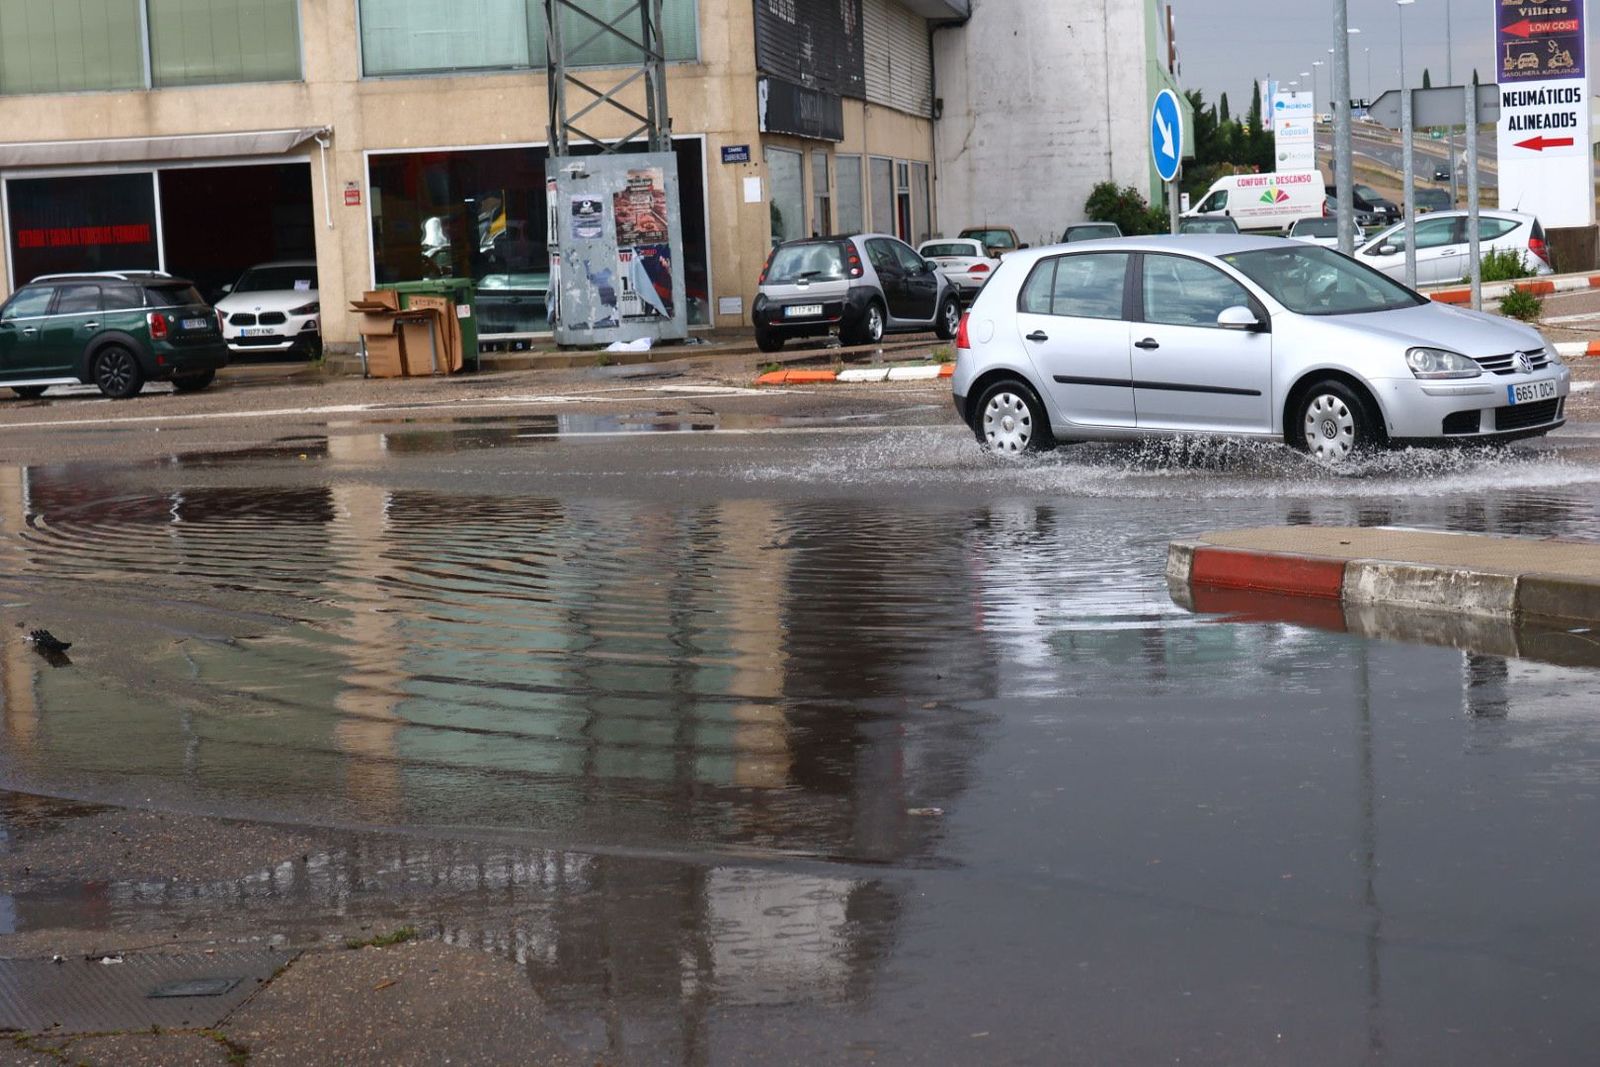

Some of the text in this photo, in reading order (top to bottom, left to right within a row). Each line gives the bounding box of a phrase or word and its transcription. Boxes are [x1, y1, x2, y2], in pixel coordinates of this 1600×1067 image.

[1519, 7, 1567, 16] Villares
[1529, 21, 1576, 32] LOW COST
[1503, 87, 1581, 107] NEUMÁTICOS
[1508, 112, 1577, 131] ALINEADOS
[1237, 177, 1268, 187] CONFORT
[1275, 174, 1311, 184] DESCANSO
[1515, 382, 1555, 401] 6651 DCH
